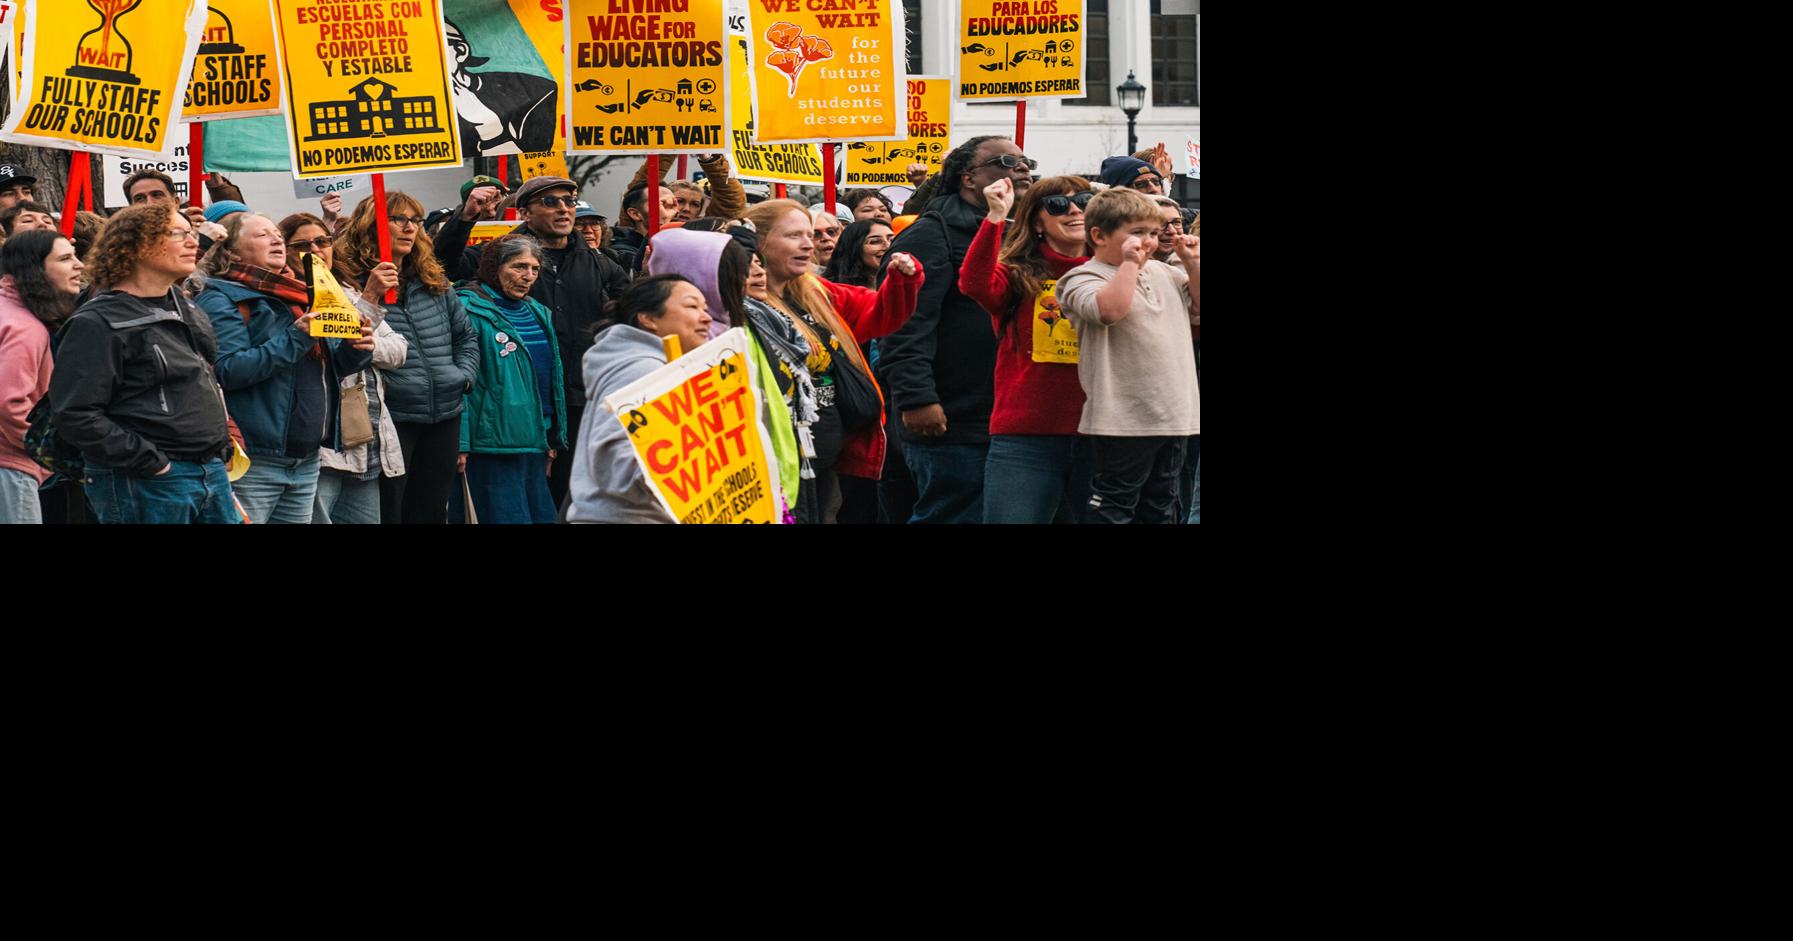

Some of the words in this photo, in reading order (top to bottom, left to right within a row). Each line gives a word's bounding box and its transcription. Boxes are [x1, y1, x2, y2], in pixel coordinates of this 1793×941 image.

[297, 3, 384, 24] ESCUELAS
[391, 1, 422, 18] CON
[608, 0, 688, 13] LIVING
[762, 0, 800, 13] WE
[993, 2, 1029, 16] PARA
[1034, 0, 1057, 15] LOS
[320, 20, 408, 41] PERSONAL
[587, 15, 660, 41] WAGE
[663, 22, 696, 39] FOR
[816, 13, 880, 28] WAIT
[968, 14, 1079, 36] EDUCADORES
[316, 38, 408, 59] COMPLETO
[852, 36, 880, 49] for
[79, 46, 126, 69] WAIT
[578, 41, 723, 68] EDUCATORS
[849, 53, 881, 63] the
[204, 54, 266, 81] STAFF
[323, 61, 333, 77] Y
[341, 56, 412, 76] ESTABLE
[820, 67, 881, 79] future
[41, 76, 97, 108] FULLY
[99, 83, 161, 116] STAFF
[183, 78, 271, 107] SCHOOLS
[848, 84, 881, 93] our
[961, 83, 977, 95] NO
[979, 82, 1032, 94] PODEMOS
[1035, 79, 1080, 92] ESPERAR
[798, 98, 882, 109] students
[25, 103, 69, 132] OUR
[70, 108, 160, 144] SCHOOLS
[804, 114, 884, 125] deserve
[907, 111, 928, 122] LOS
[574, 126, 604, 146] WE
[610, 126, 666, 146] CAN'T
[671, 125, 721, 145] WAIT
[303, 150, 322, 167] NO
[325, 145, 391, 165] PODEMOS
[396, 141, 450, 160] ESPERAR
[524, 151, 555, 159] SUPPORT
[735, 150, 763, 170] OUR
[764, 152, 821, 176] SCHOOLS
[316, 179, 352, 194] CARE
[847, 173, 860, 182] NO
[862, 172, 905, 183] PODEMOS
[652, 369, 719, 426] WE
[646, 387, 747, 475] CAN'T
[662, 424, 746, 503] WAIT
